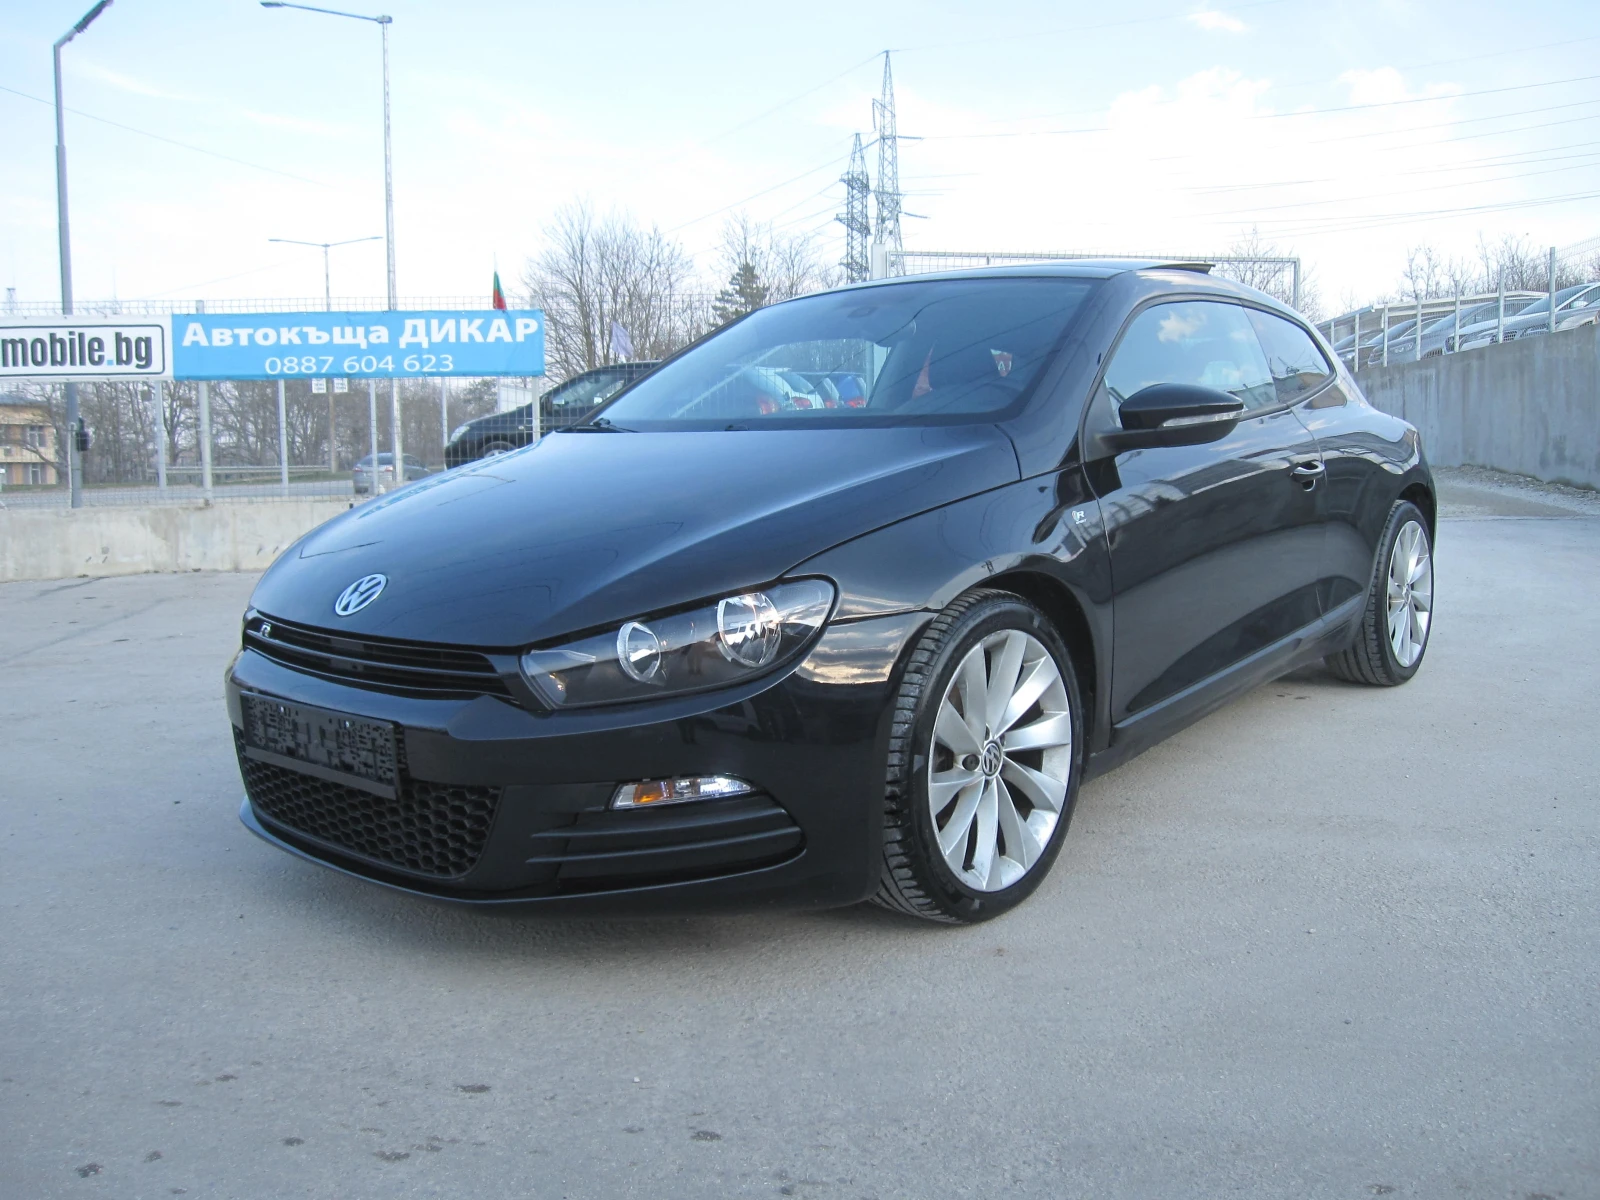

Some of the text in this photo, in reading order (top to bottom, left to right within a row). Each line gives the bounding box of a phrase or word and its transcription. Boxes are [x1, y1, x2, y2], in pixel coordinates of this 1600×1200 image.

[182, 318, 538, 349] Автокъща ДИКАР
[1, 331, 152, 369] mobile.bg
[265, 354, 454, 374] 0887 604 623
